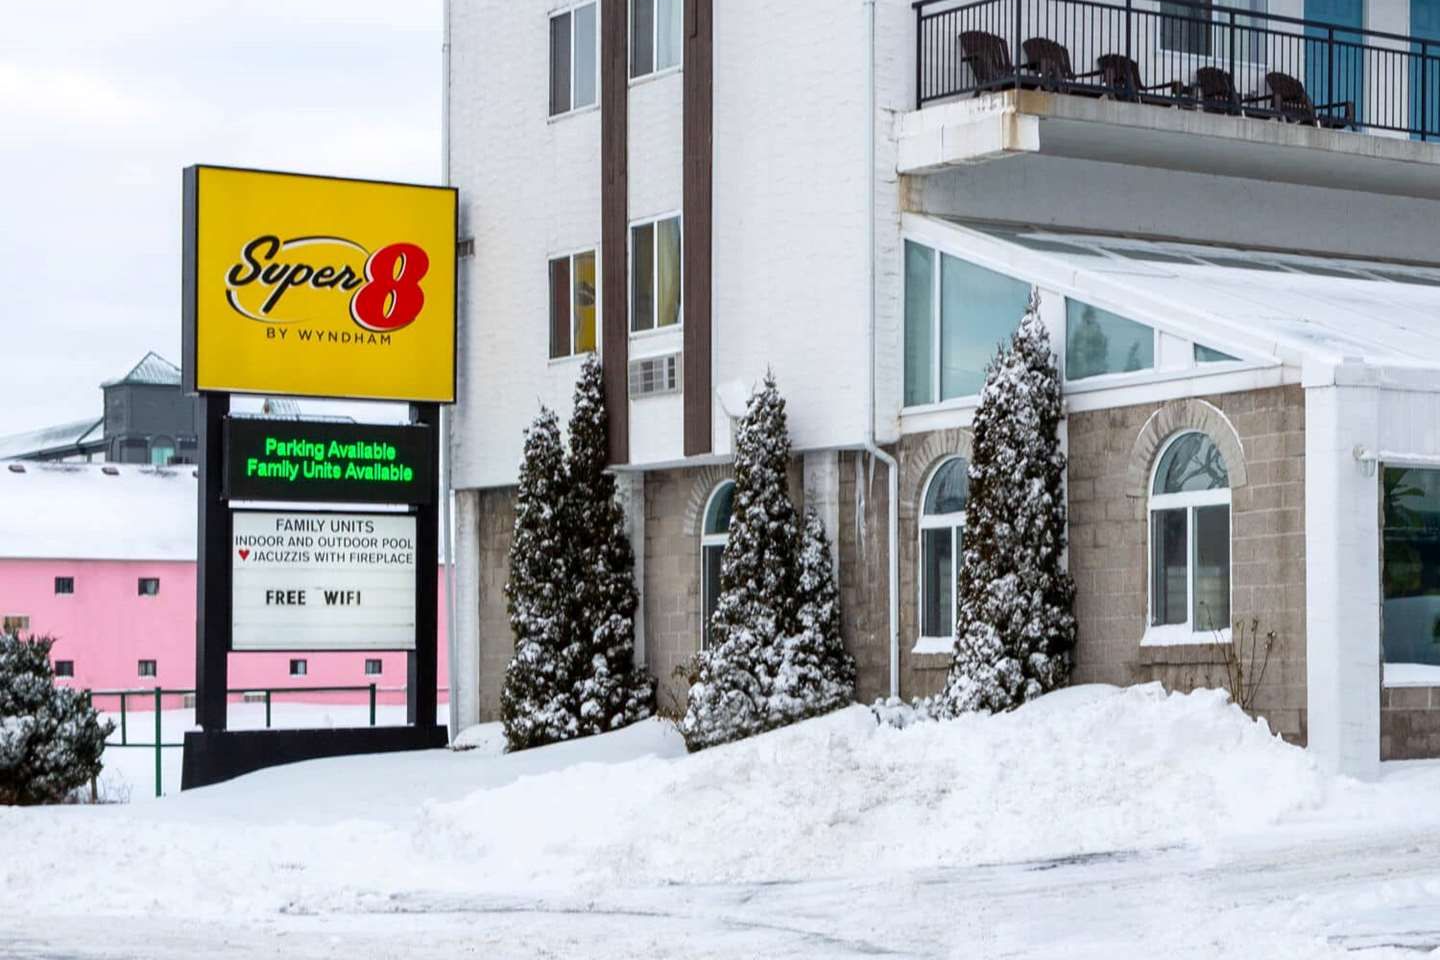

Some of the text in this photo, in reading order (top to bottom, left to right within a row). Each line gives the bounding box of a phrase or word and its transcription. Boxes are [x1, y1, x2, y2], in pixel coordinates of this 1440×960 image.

[228, 235, 430, 332] Super 8
[266, 327, 392, 346] BY WYNDHAM
[265, 438, 396, 461] Parking Available
[247, 459, 413, 482] Family Units Available
[275, 518, 375, 534] FAMILY UNITS
[235, 535, 414, 550] INDOOR AND OUTDOOR POOL
[252, 551, 413, 565] JACUZZIS WITH FIREPLACE
[265, 590, 362, 606] FREE WIFI
